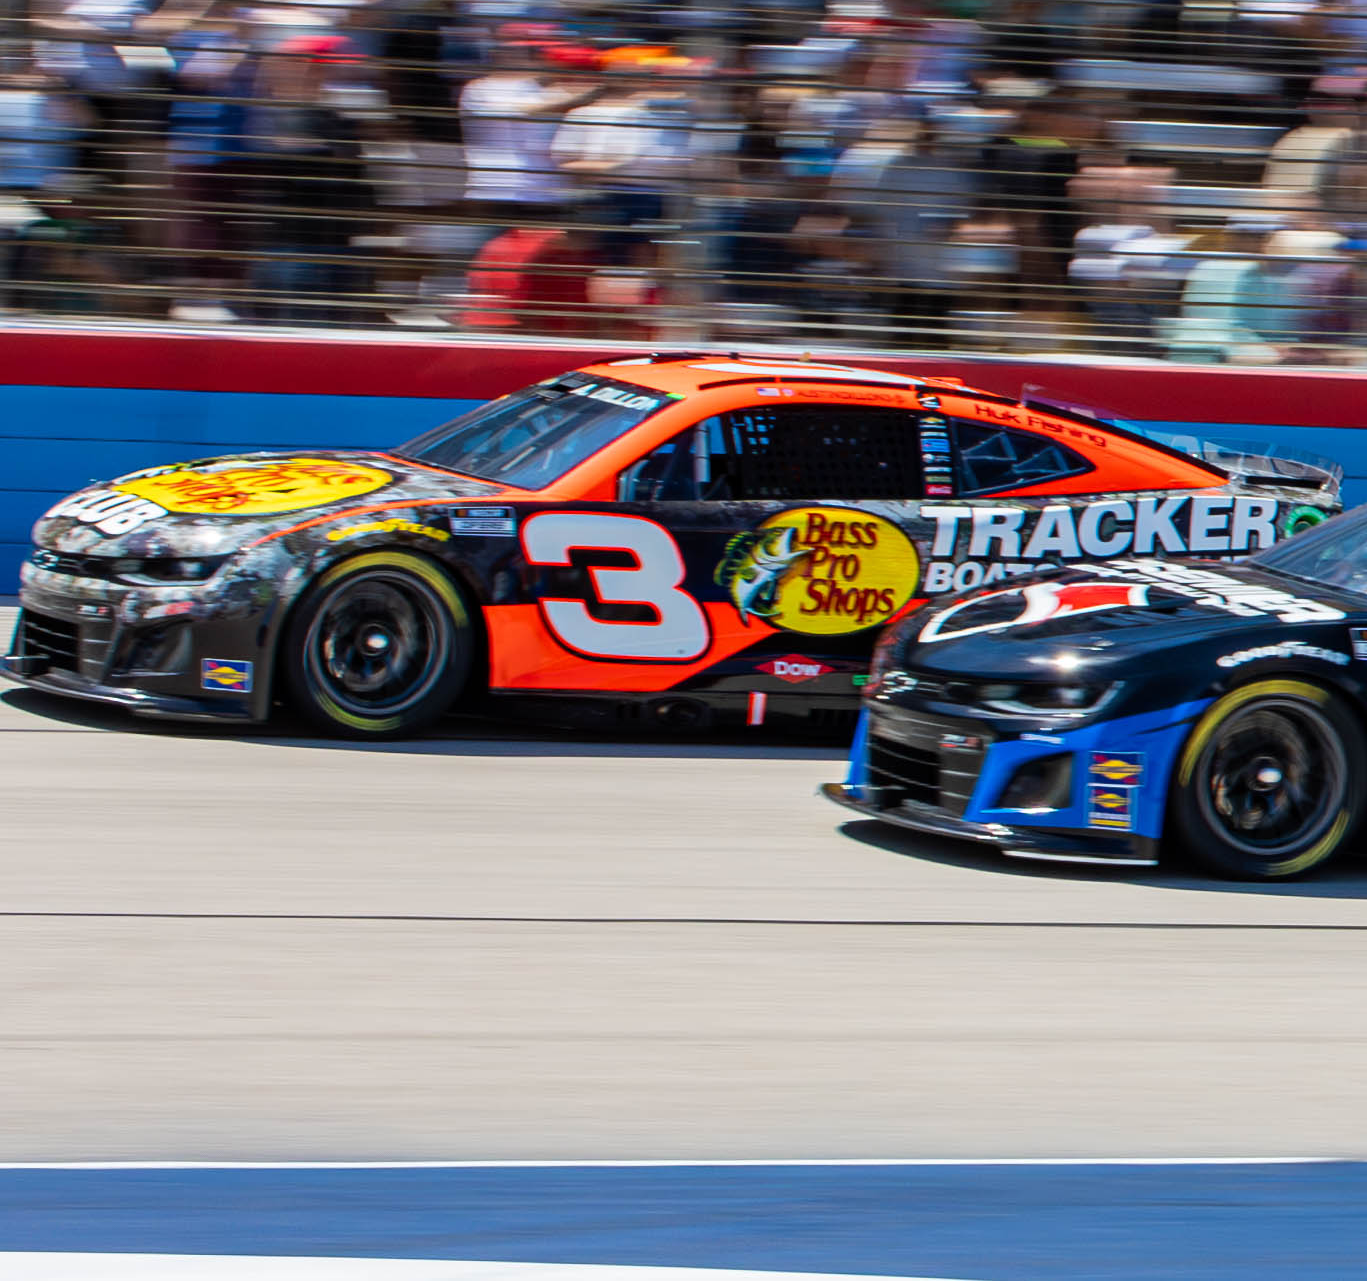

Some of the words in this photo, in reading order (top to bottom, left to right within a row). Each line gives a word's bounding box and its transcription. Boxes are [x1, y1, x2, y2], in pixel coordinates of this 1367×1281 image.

[1027, 416, 1107, 447] Fishing
[800, 513, 879, 547] Bass
[920, 496, 1280, 559] TRACKER
[800, 546, 860, 581] Pro
[923, 561, 1060, 594] BOA
[518, 511, 711, 663] 3
[800, 578, 896, 624] Shops
